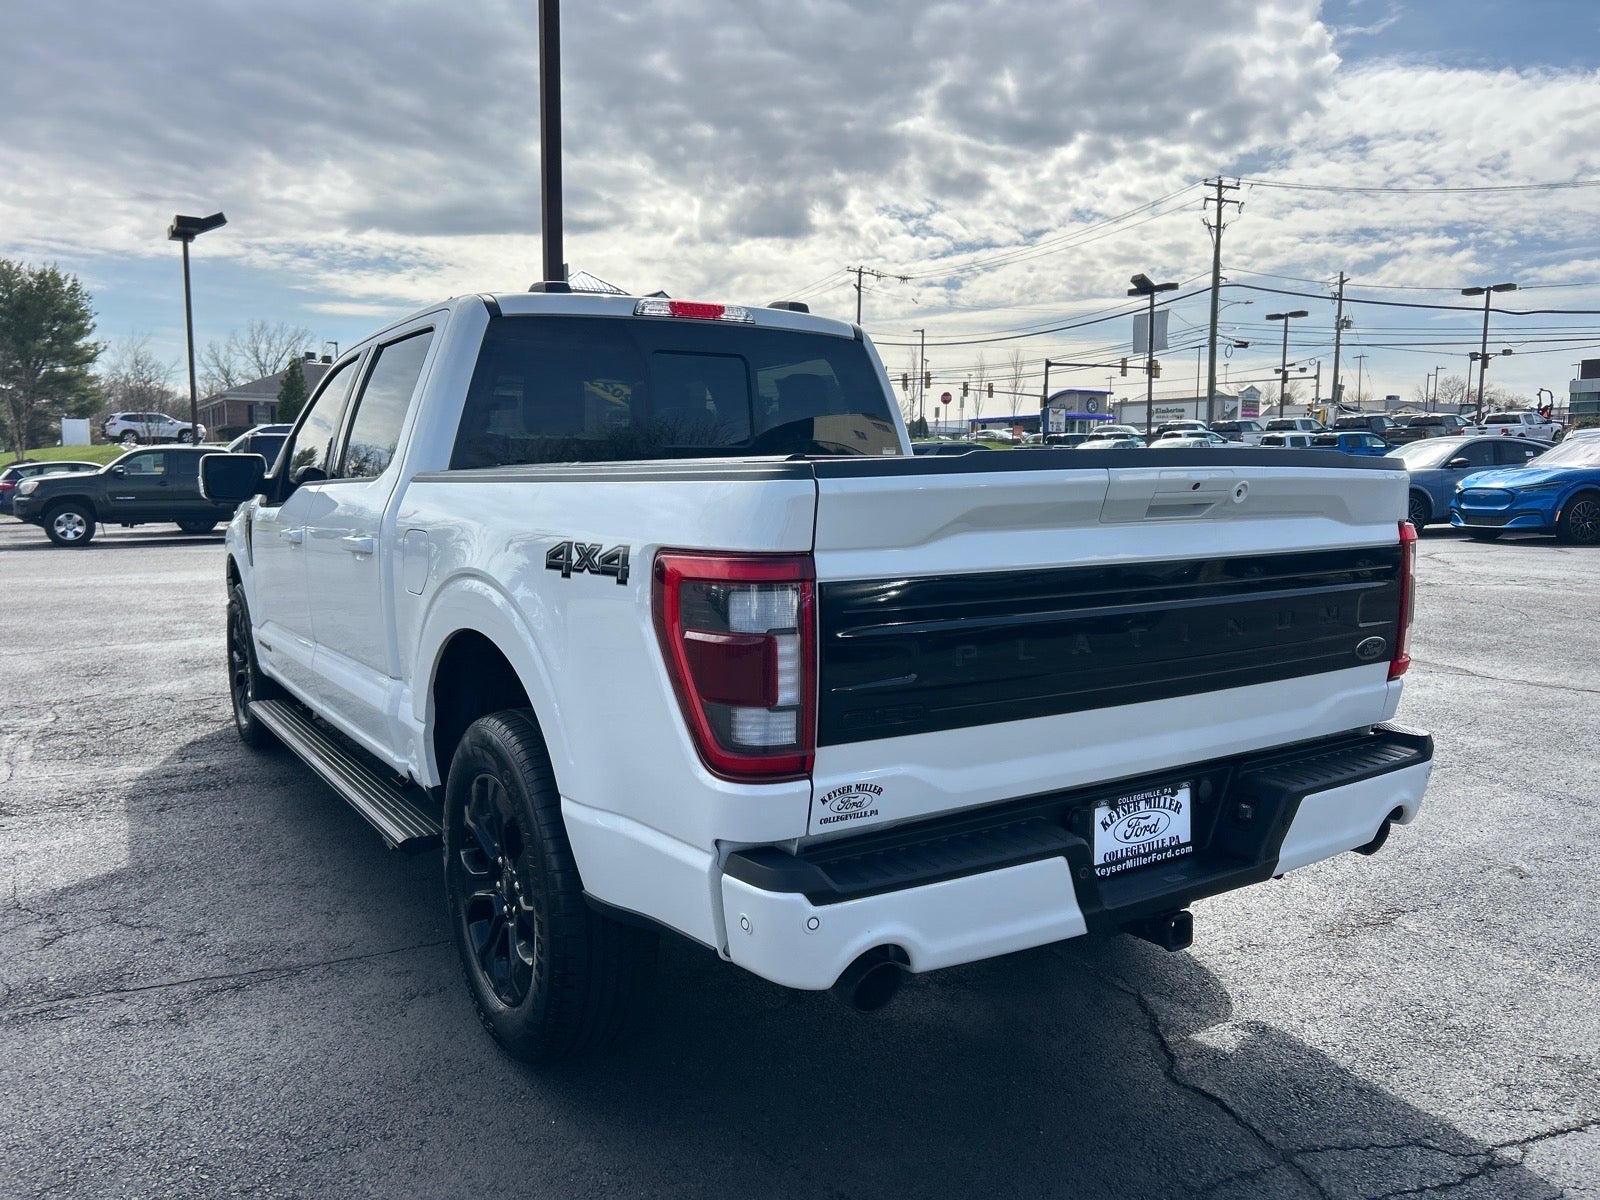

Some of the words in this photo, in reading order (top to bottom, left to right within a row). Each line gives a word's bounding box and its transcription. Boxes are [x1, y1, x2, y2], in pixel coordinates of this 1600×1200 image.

[951, 603, 1342, 668] PLATINUM
[820, 785, 853, 806] KEYSER
[854, 783, 884, 796] MILLER
[836, 795, 866, 811] Ford
[1100, 803, 1141, 832] KEYSER
[1144, 796, 1183, 815] MILLER
[1123, 815, 1161, 840] Ford
[1095, 845, 1193, 877] KeyserMillerFord.com
